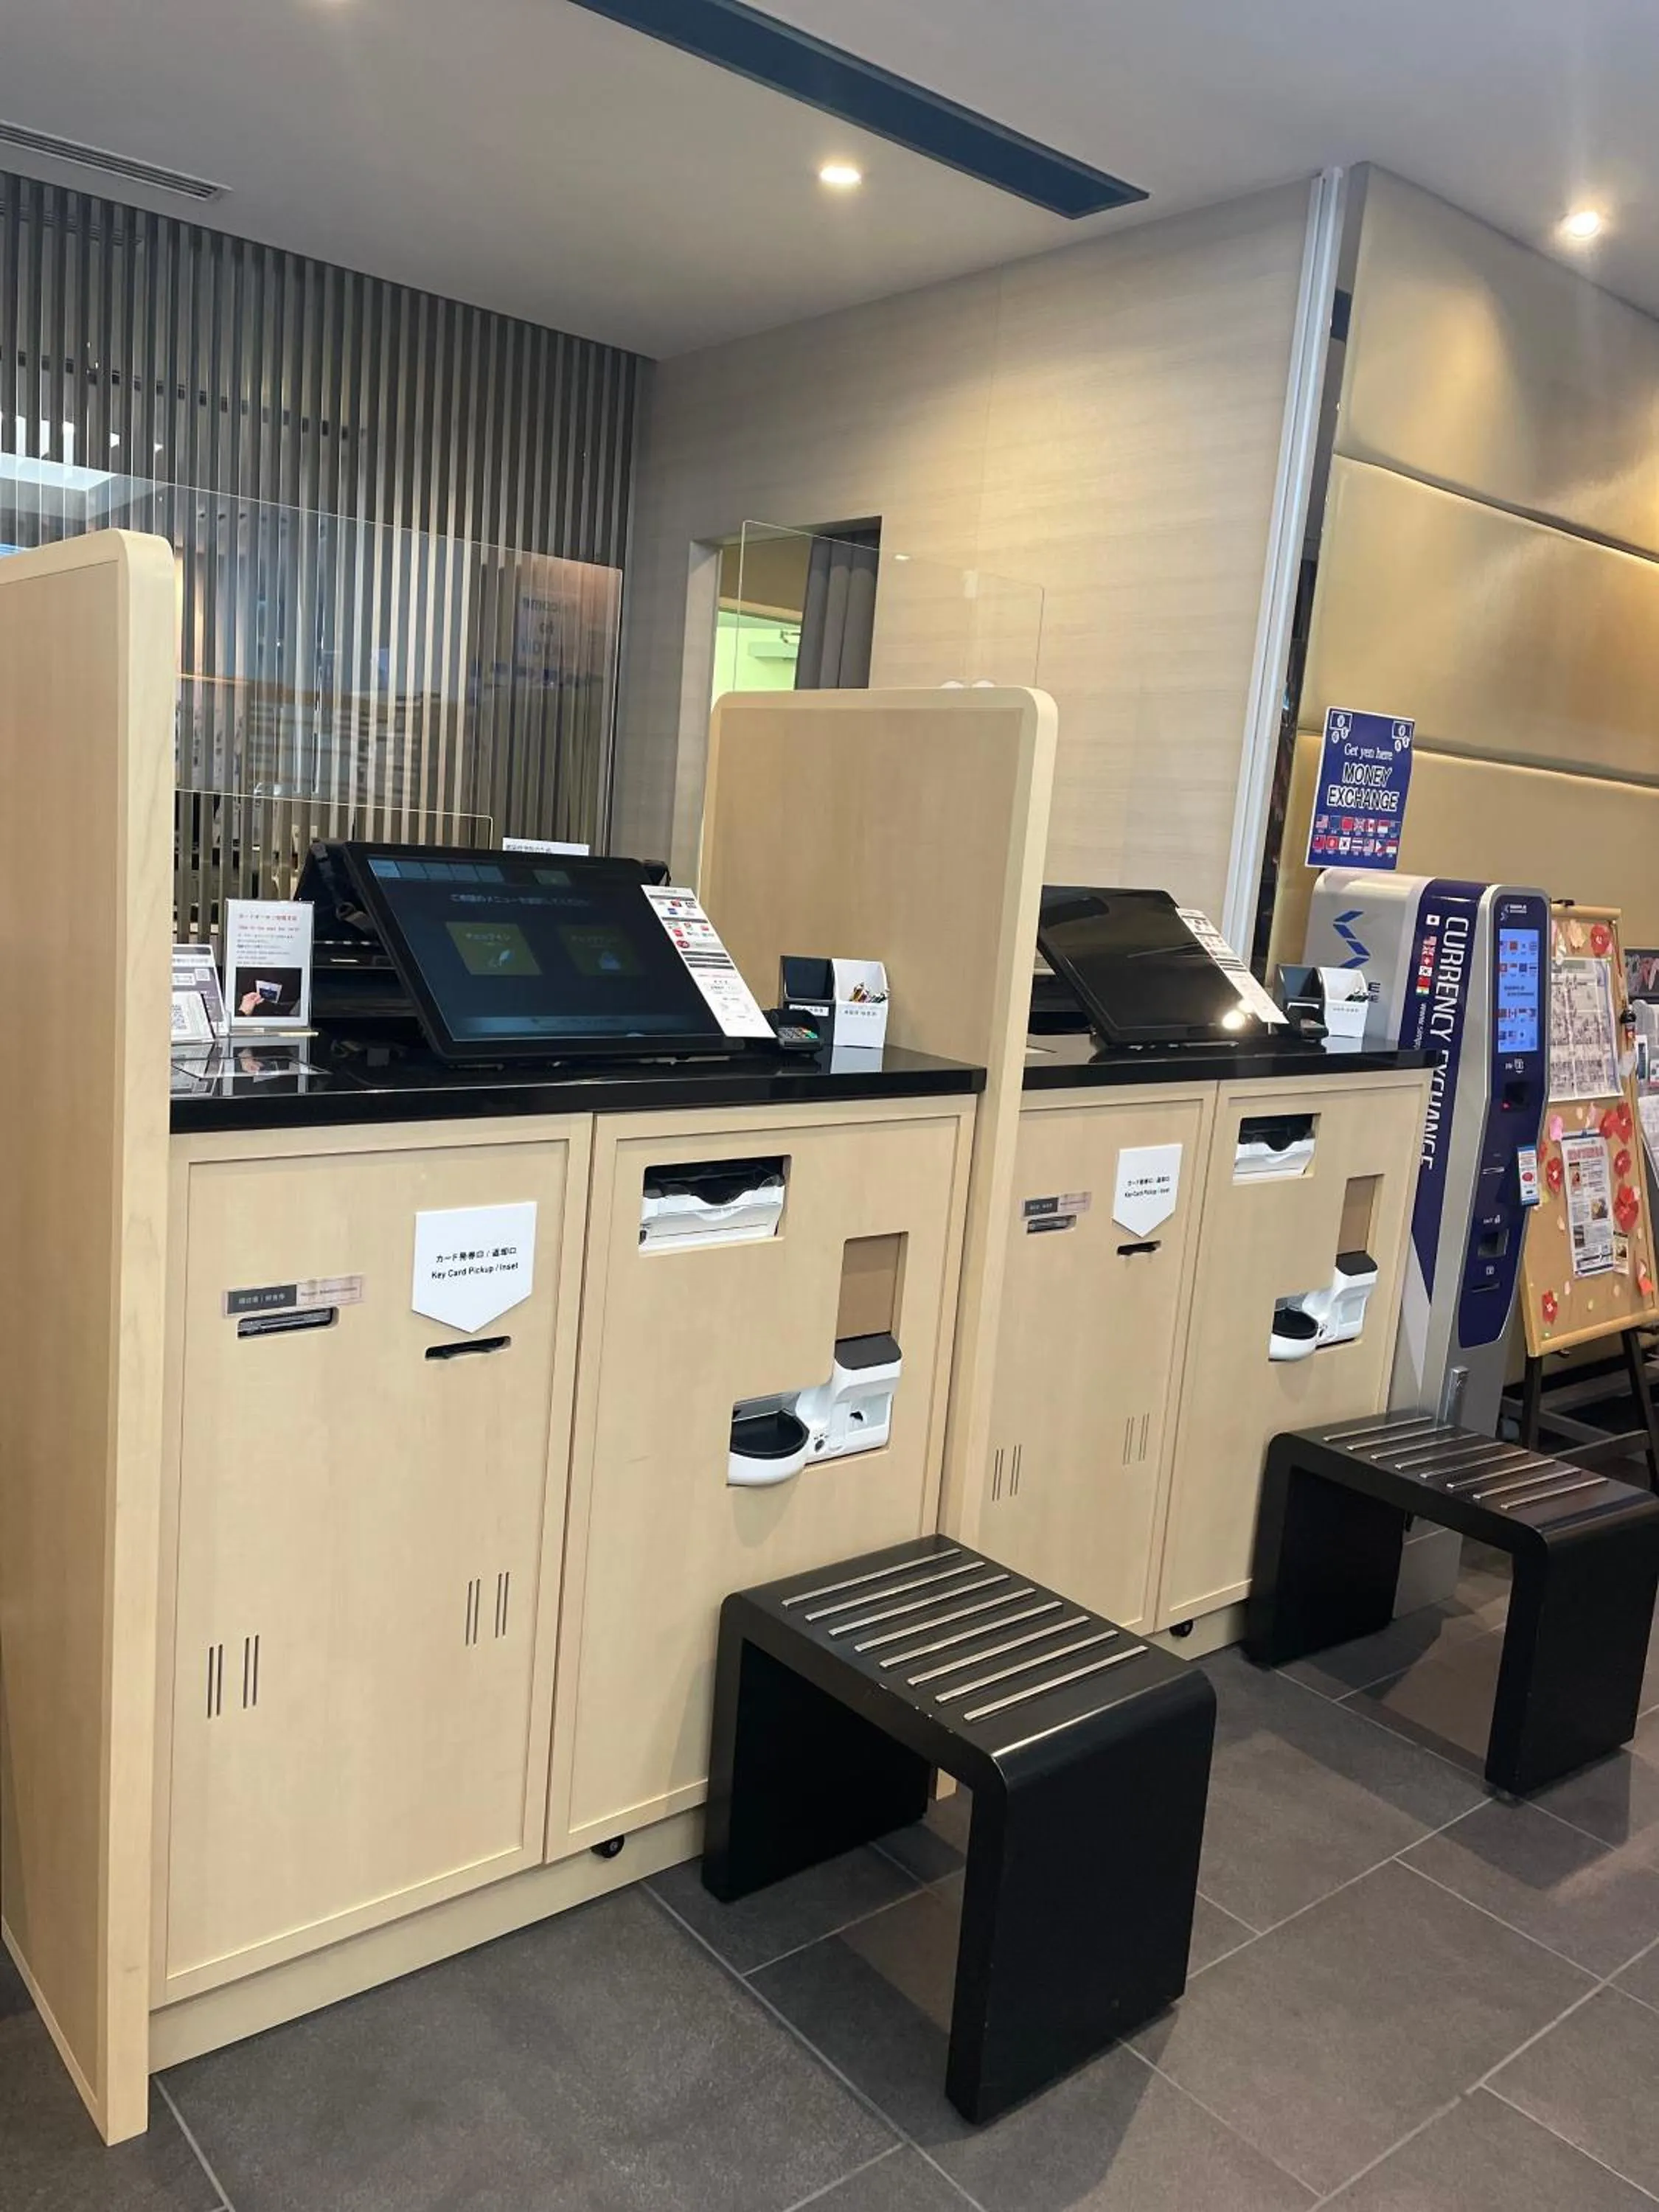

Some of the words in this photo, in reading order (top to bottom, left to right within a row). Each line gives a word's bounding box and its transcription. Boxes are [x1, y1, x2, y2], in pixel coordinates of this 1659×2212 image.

[1345, 742, 1358, 756] Get
[1342, 762, 1393, 787] MONEY
[1326, 785, 1399, 812] EXCHANGE
[1430, 917, 1470, 1043] CURRENCY
[431, 1270, 446, 1280] Key
[448, 1267, 467, 1279] Card
[468, 1265, 494, 1276] Pickup
